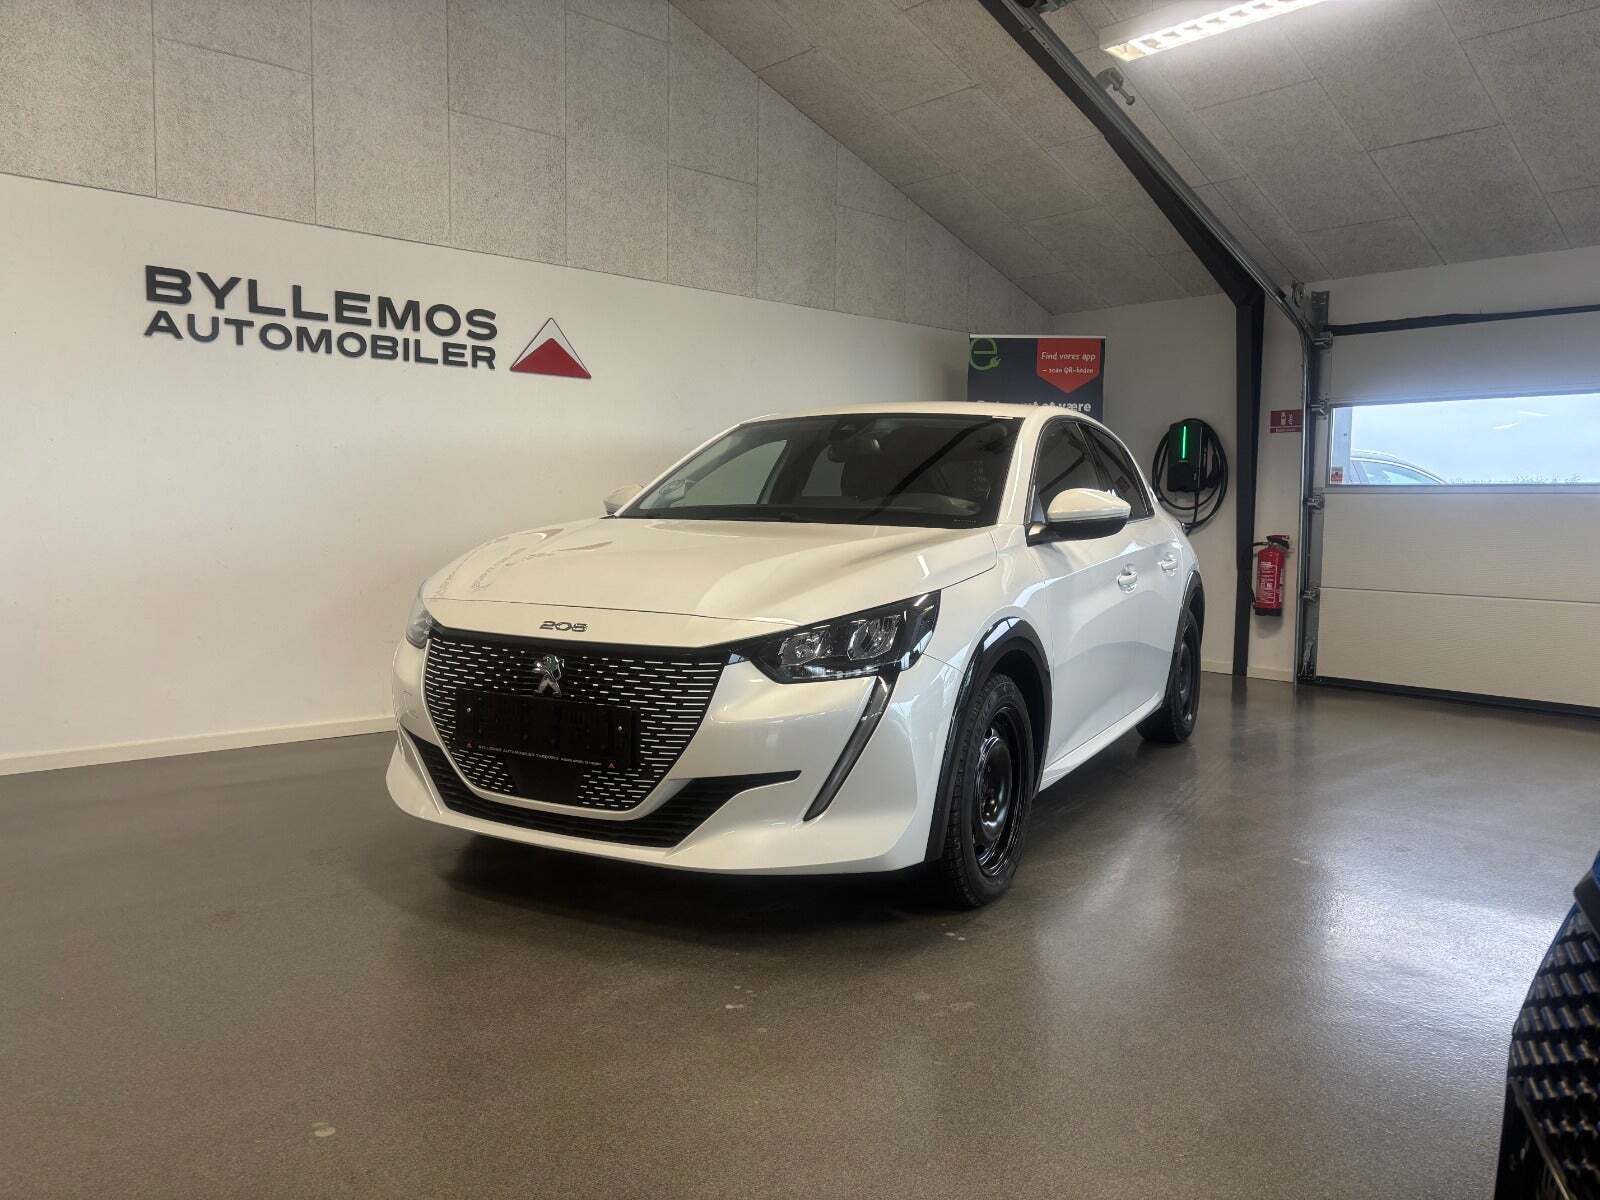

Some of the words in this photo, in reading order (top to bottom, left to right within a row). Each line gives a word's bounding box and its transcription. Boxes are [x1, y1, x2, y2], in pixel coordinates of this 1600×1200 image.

[145, 264, 498, 341] BYLLEMOS
[143, 310, 496, 370] AUTOMOBILER
[1041, 351, 1058, 361] Find
[1059, 353, 1081, 361] vores
[1082, 353, 1097, 363] app
[539, 620, 588, 632] 208
